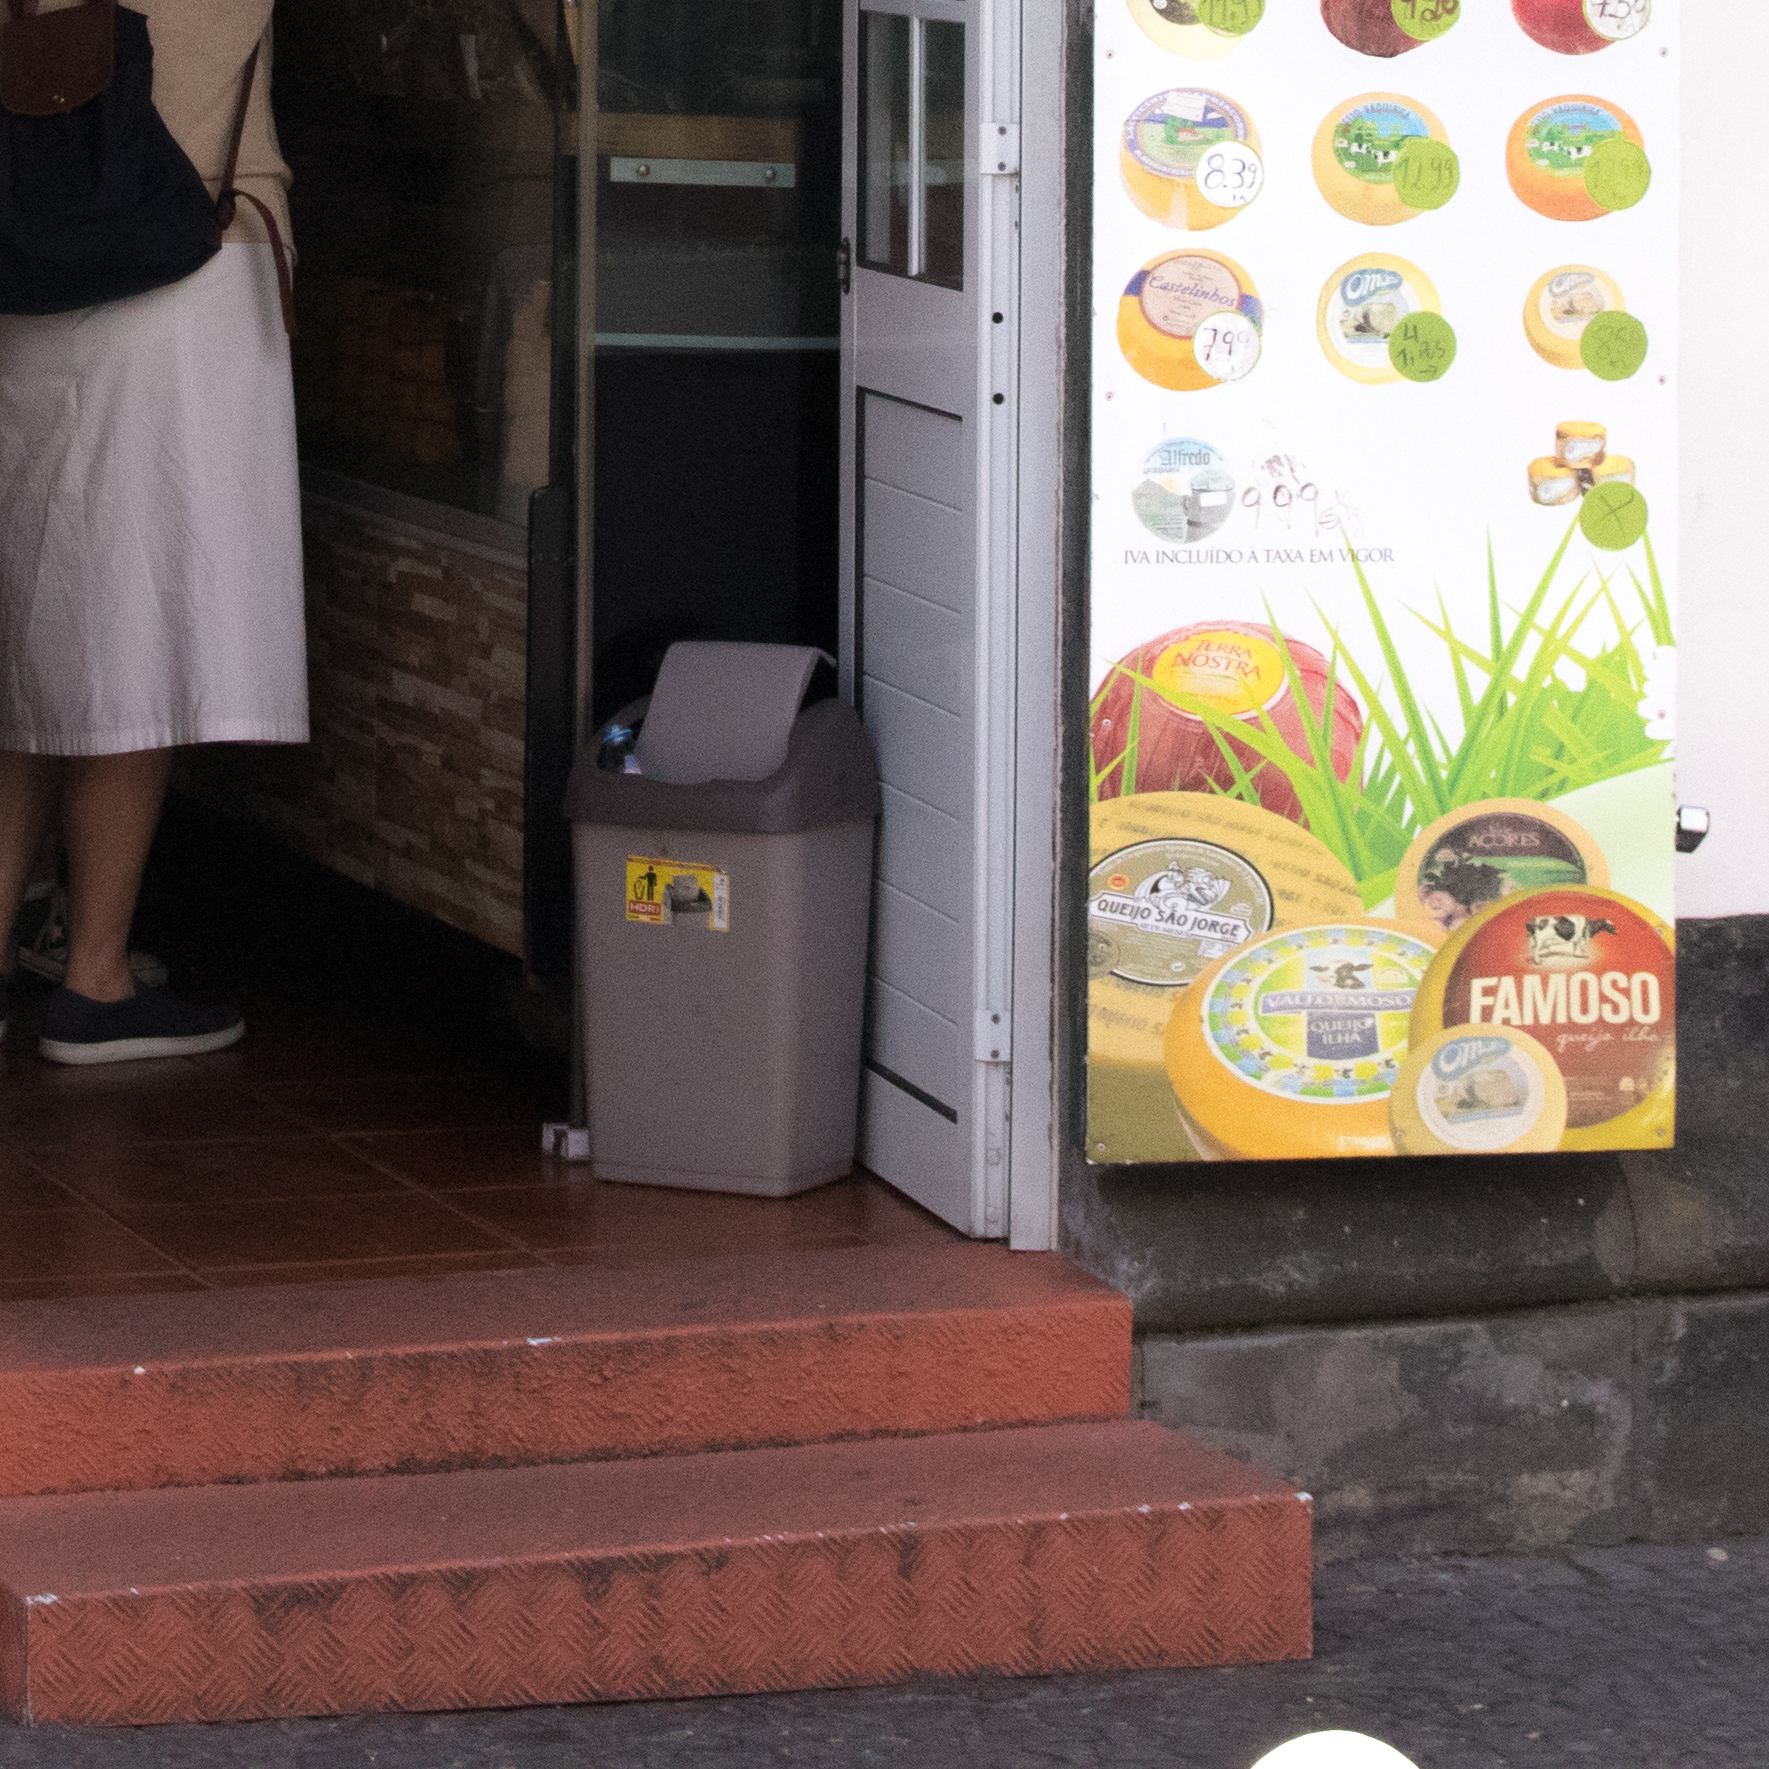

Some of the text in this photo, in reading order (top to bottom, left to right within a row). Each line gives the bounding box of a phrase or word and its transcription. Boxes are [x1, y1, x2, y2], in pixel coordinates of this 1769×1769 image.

[1204, 153, 1257, 190] 8.39
[1148, 276, 1236, 307] Castelinhos
[1160, 449, 1211, 466] Alfredo
[1124, 545, 1394, 564] IVA INCLUÍDO À TAXA EM VIGOR
[1196, 639, 1253, 661] TERRA
[1171, 652, 1261, 681] NOSTRA
[1097, 898, 1152, 920] QUEIJO
[1190, 916, 1243, 938] JORGE
[1468, 971, 1661, 1025] FAMOSO
[1321, 1031, 1361, 1045] ILHA
